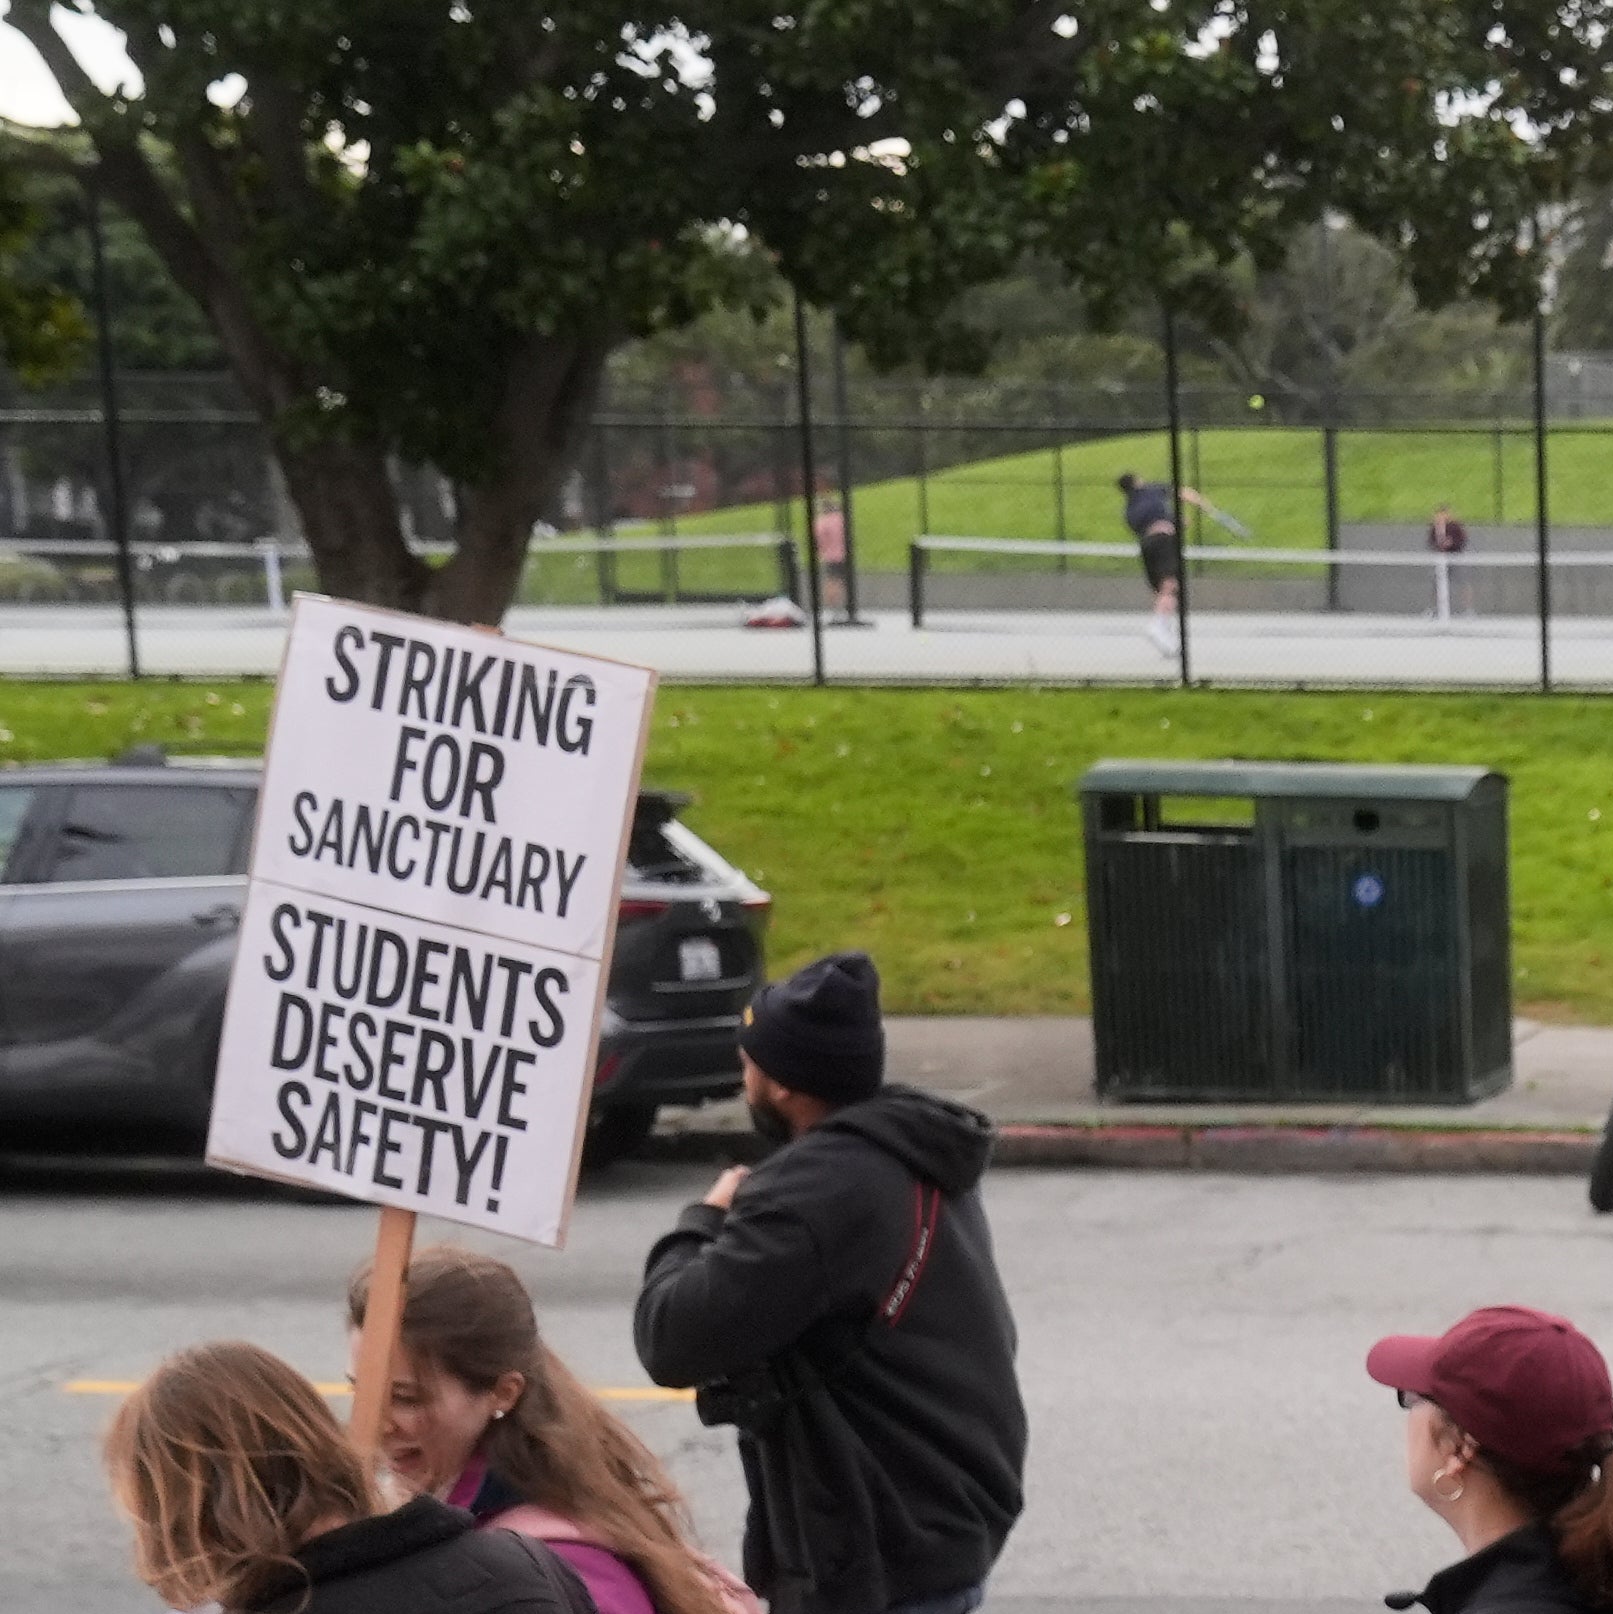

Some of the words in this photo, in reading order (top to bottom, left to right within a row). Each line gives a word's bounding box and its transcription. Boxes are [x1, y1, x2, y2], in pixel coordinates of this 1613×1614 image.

[324, 624, 598, 757] STRIKING
[389, 724, 506, 824] FOR
[287, 790, 588, 919] SANCTUARY
[263, 902, 570, 1049] STUDENTS
[269, 990, 537, 1132] DESERVE
[271, 1079, 510, 1214] SAFETY!
